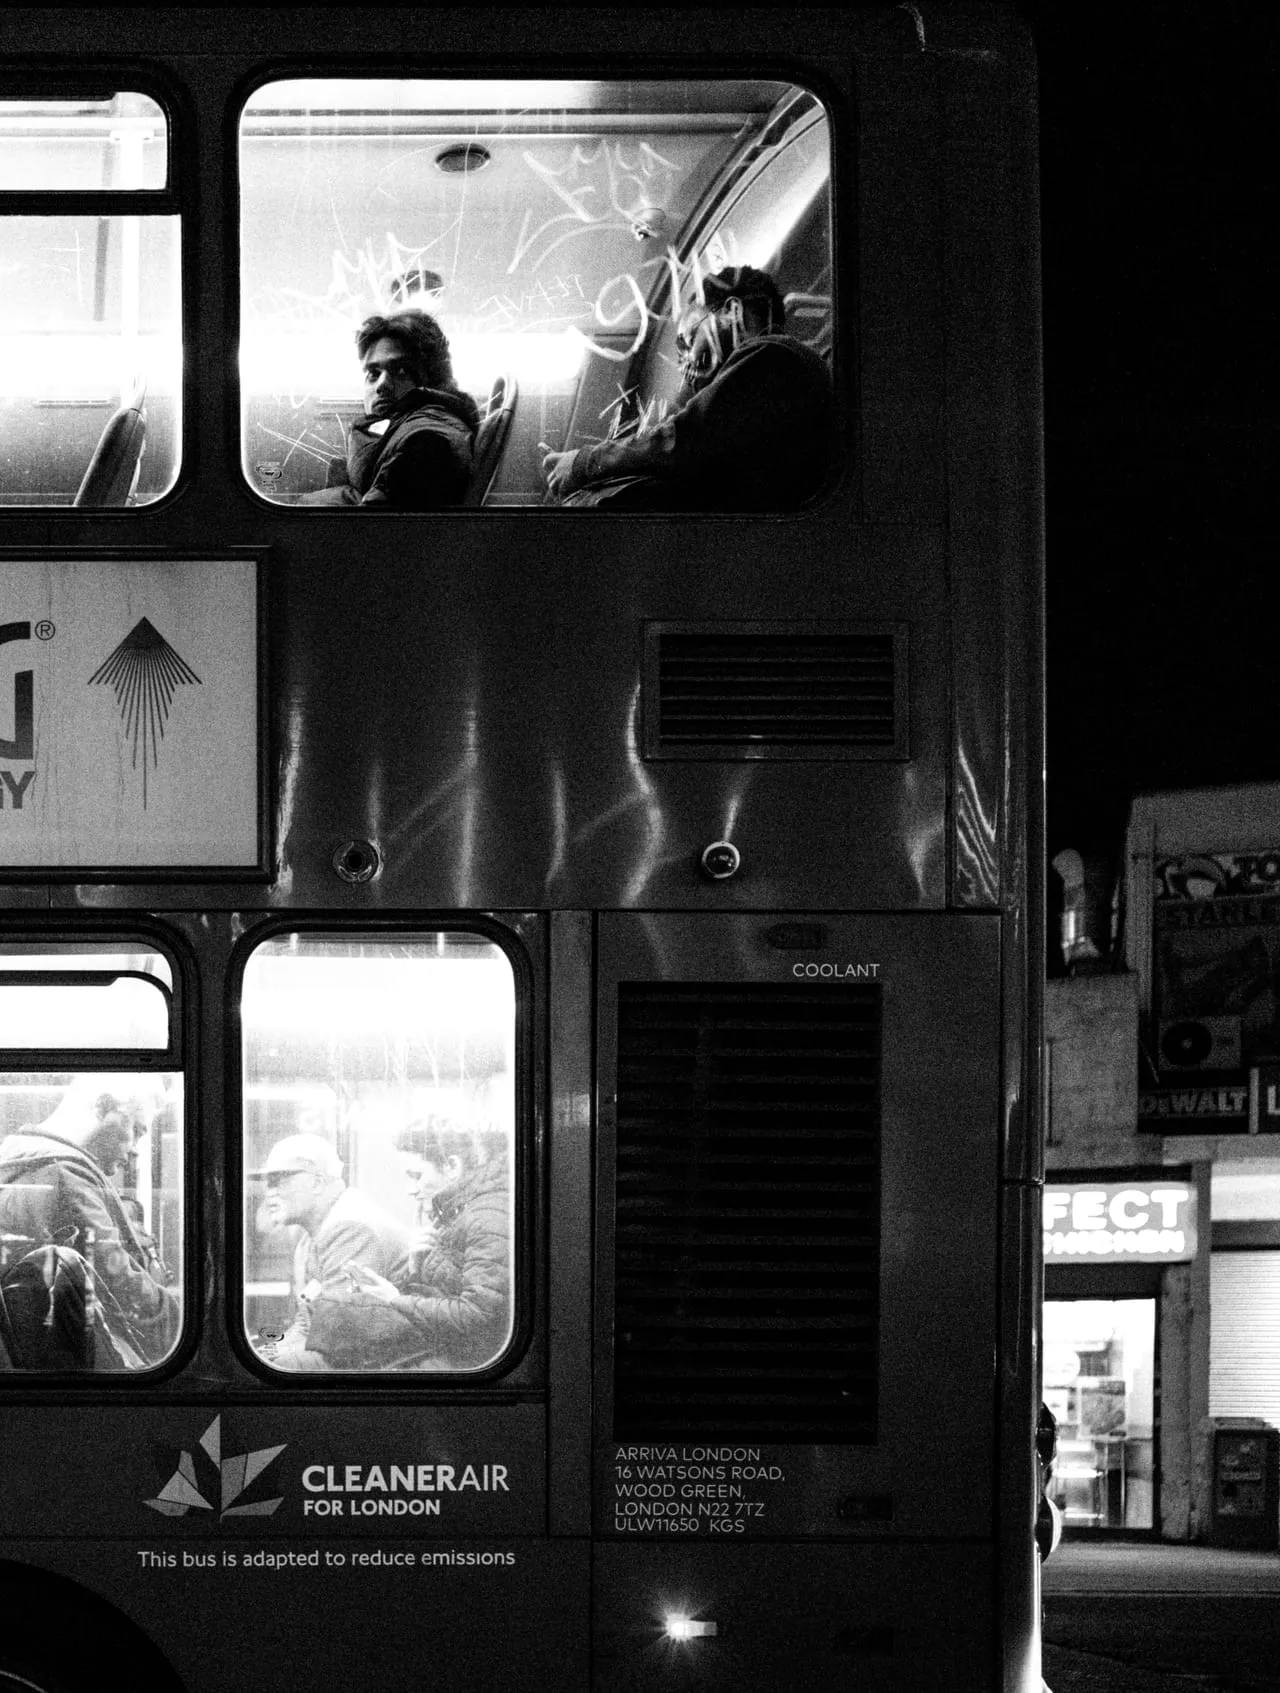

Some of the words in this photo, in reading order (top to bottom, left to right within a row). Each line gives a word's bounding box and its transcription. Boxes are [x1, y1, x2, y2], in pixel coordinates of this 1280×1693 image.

[792, 963, 881, 978] COOLANT
[615, 1447, 678, 1461] ARRIVA
[683, 1447, 761, 1462] LONDON
[615, 1466, 632, 1480] 16
[636, 1466, 726, 1480] WATSONS
[731, 1466, 786, 1482] ROAD,
[615, 1484, 675, 1498] WOOD
[680, 1484, 746, 1500] GREEN,
[303, 1500, 344, 1516] FOR
[350, 1500, 441, 1516] LONDON
[615, 1502, 692, 1516] LONDON
[698, 1503, 729, 1516] N22
[734, 1503, 765, 1517] 7TZ
[614, 1518, 700, 1532] ULW11650
[709, 1519, 745, 1533] KGS
[138, 1550, 177, 1568] This
[183, 1550, 217, 1568] bus
[222, 1550, 237, 1568] is
[243, 1550, 320, 1572] adapted
[325, 1552, 347, 1568] to
[351, 1550, 415, 1568] reduce
[421, 1551, 516, 1568] emissions
